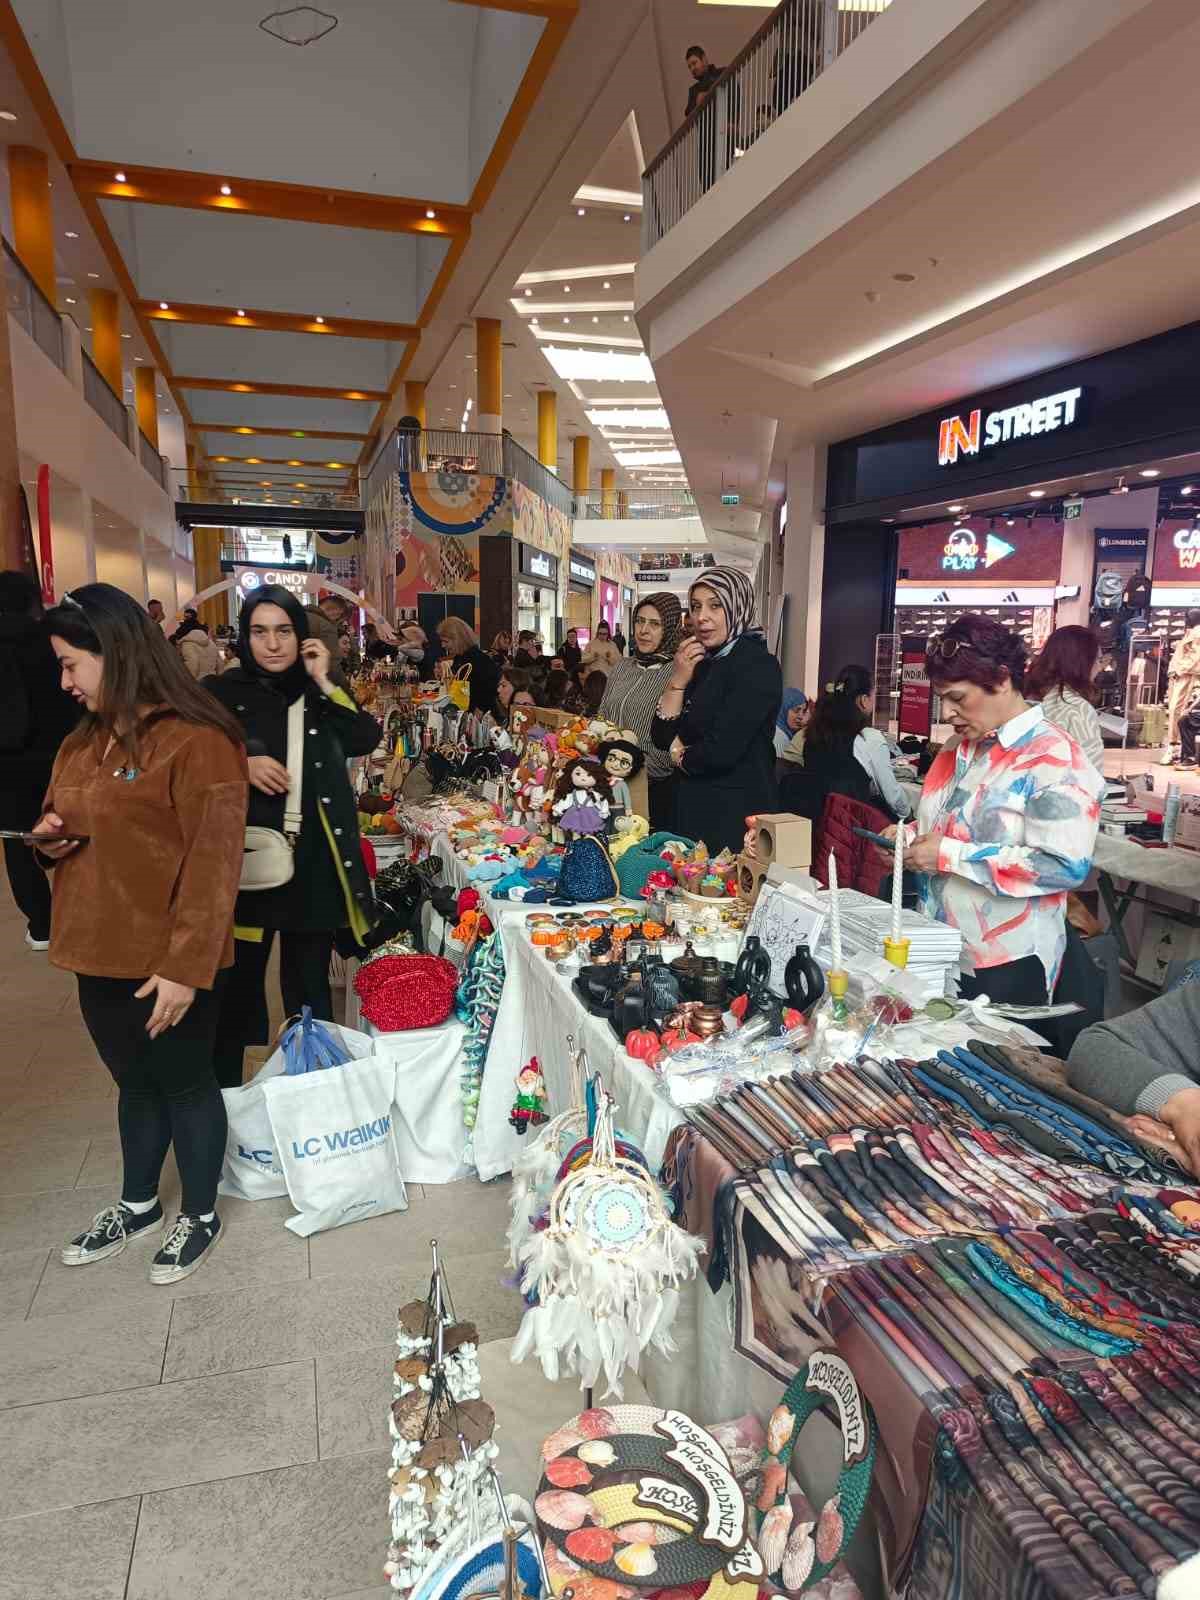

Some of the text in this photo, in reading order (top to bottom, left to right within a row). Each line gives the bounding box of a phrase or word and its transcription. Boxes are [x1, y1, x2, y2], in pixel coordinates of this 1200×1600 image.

[938, 387, 1081, 466] IN STREET
[942, 556, 978, 570] PLAY
[263, 571, 308, 585] CANDY
[292, 1137, 321, 1159] LC
